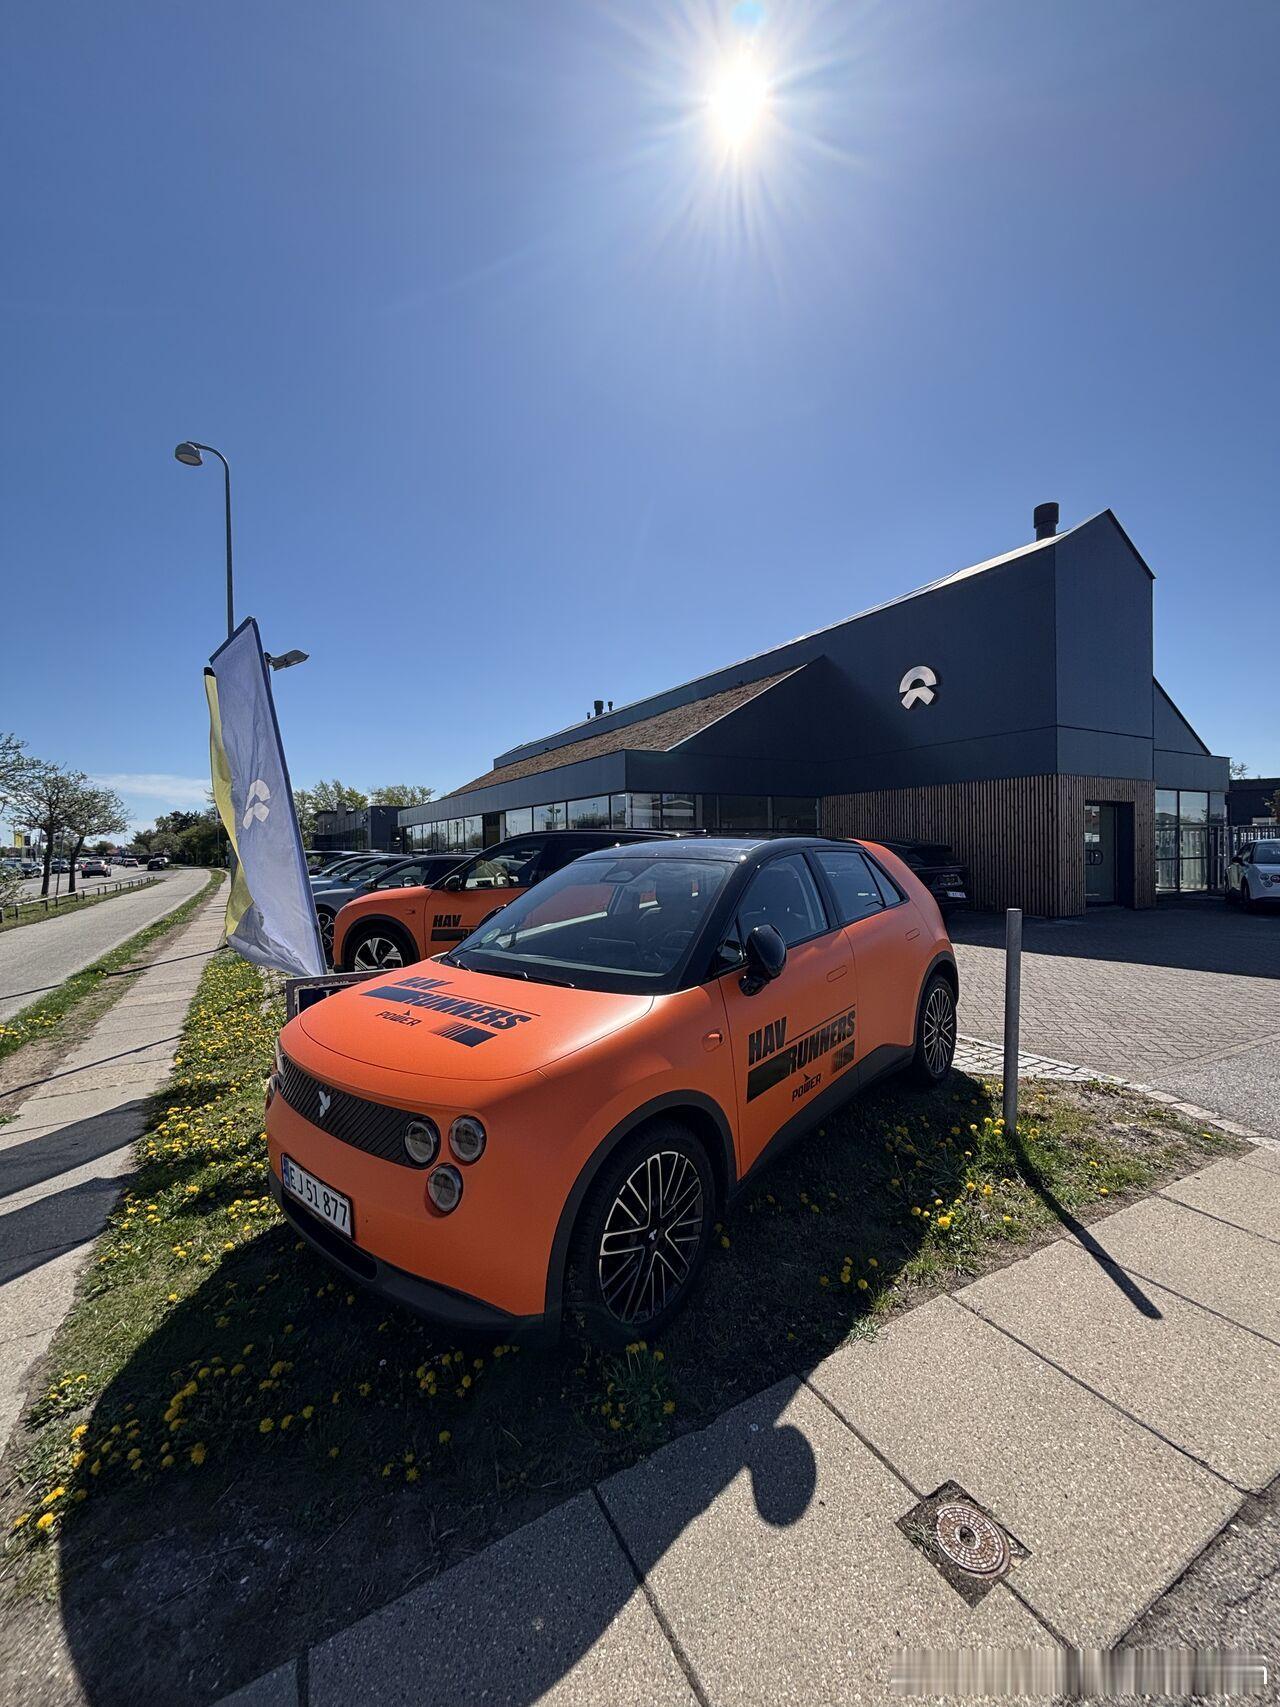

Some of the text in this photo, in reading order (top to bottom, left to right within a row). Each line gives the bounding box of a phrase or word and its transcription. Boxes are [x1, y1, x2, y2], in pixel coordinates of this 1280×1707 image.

[431, 914, 462, 928] HAV
[392, 976, 454, 990] HAV
[376, 1010, 422, 1027] POWER
[397, 990, 532, 1030] RUNNERS
[748, 1015, 787, 1067] HAV
[785, 1010, 856, 1076] RUNNERS
[791, 1073, 822, 1102] POWER
[323, 1190, 347, 1227] 877
